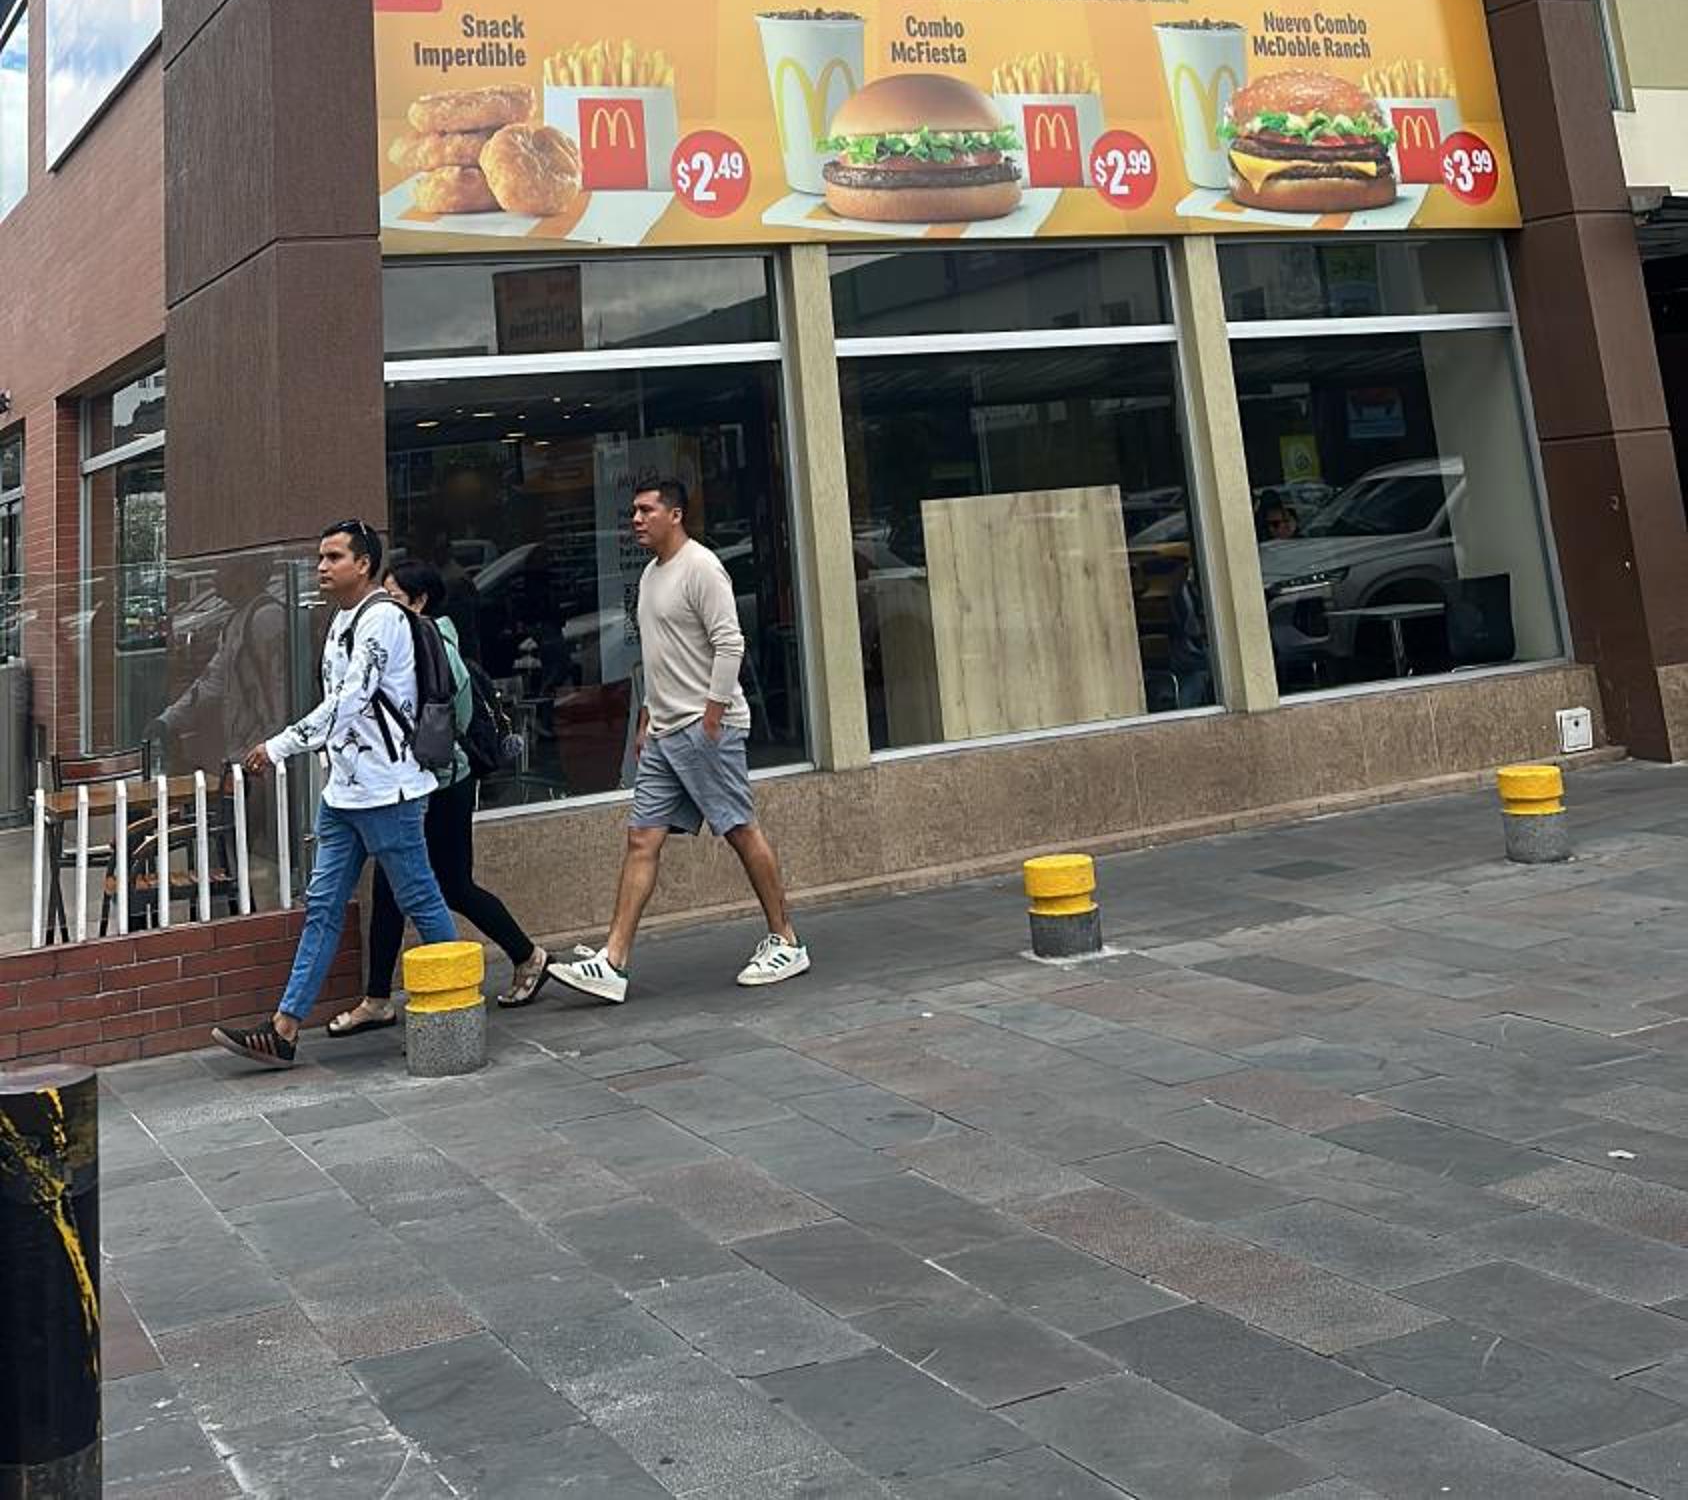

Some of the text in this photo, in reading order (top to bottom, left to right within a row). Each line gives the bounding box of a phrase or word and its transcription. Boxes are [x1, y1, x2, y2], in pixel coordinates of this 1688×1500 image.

[461, 13, 525, 39] Snack
[904, 16, 965, 40] Combo
[1263, 12, 1367, 35] Nuevo Combo
[413, 41, 527, 72] Imperdible
[890, 41, 967, 65] McFiesta
[1252, 35, 1371, 59] McDoble Ranch
[676, 151, 744, 202] $2.49
[1094, 150, 1152, 197] $2.99
[1442, 149, 1494, 192] $3.99
